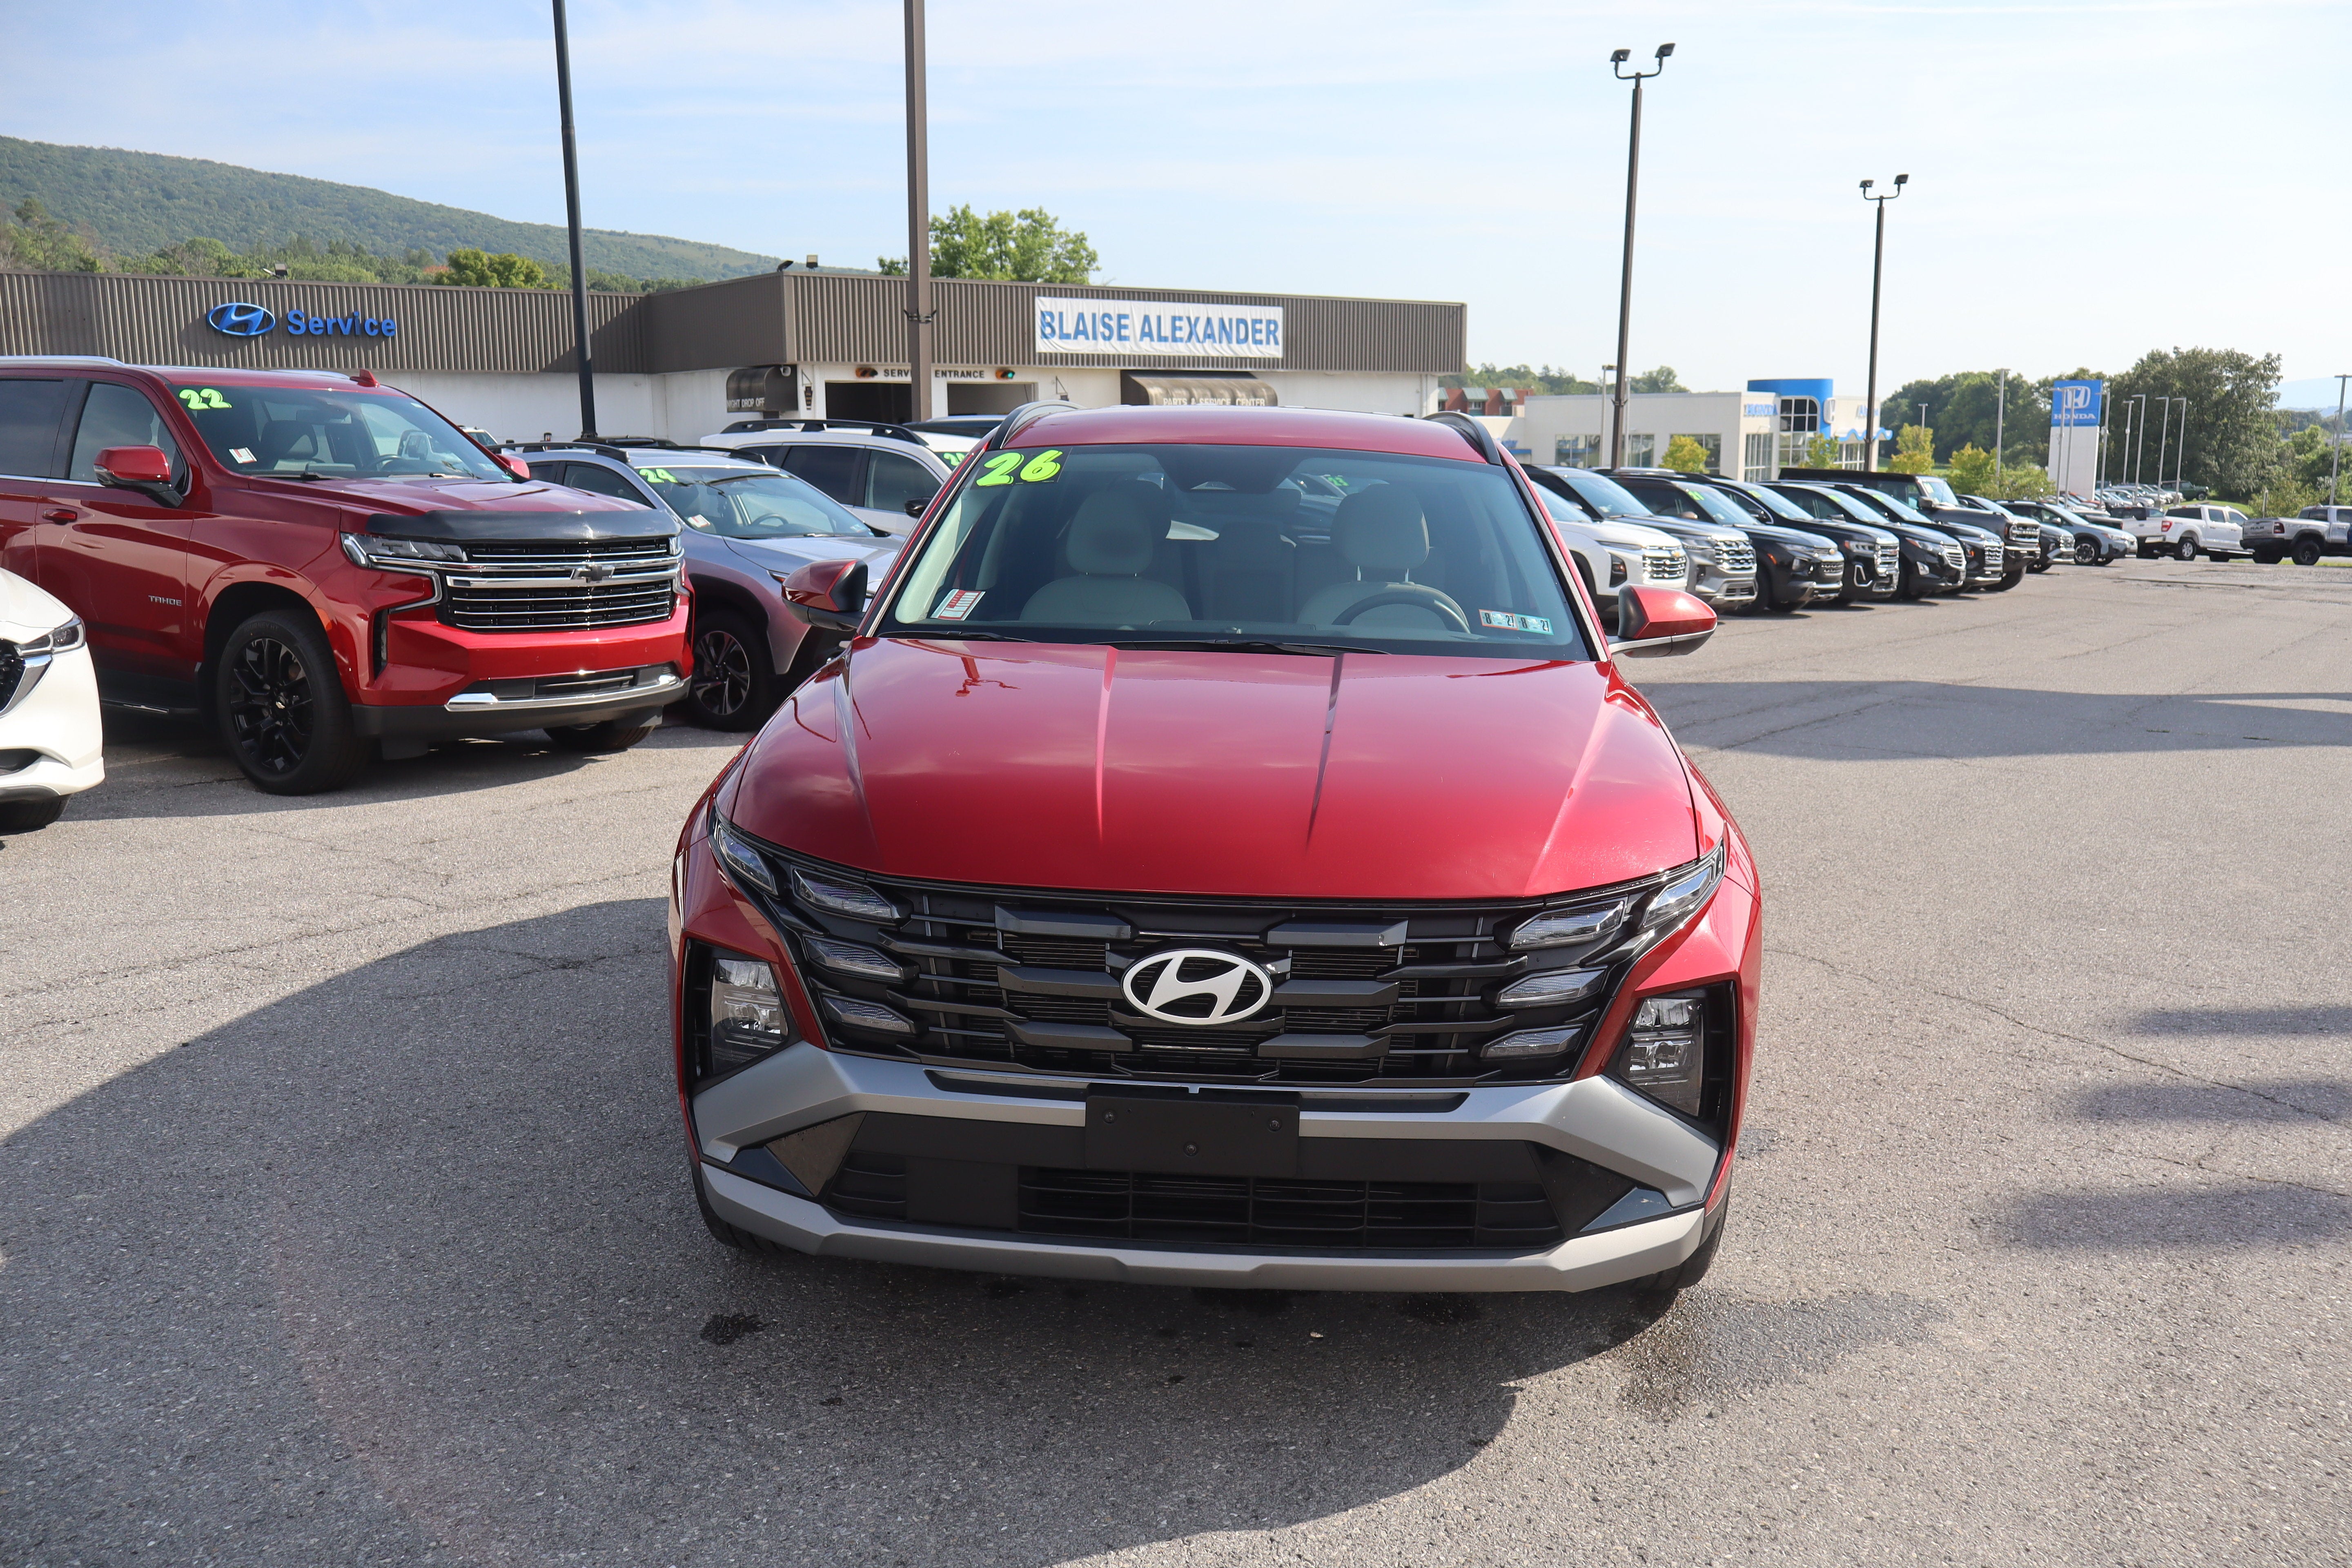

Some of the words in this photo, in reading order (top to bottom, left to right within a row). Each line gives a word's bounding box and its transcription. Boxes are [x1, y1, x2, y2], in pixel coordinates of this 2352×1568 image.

[287, 309, 396, 336] Service
[1041, 310, 1130, 341] BLAISE
[1139, 314, 1280, 346] ALEXANDER
[884, 369, 913, 377] SERV
[935, 370, 984, 378] ENTRANCE
[179, 388, 232, 410] 22
[727, 399, 740, 408] NIGHT
[742, 398, 754, 408] DROP
[755, 397, 765, 407] OFF
[1746, 403, 1778, 415] HONDA
[639, 468, 678, 483] 24
[976, 450, 1063, 487] 26
[148, 595, 182, 606] TAHOE
[1484, 612, 1492, 624] 8
[1506, 615, 1514, 628] 27
[1520, 617, 1528, 629] 8
[1541, 620, 1549, 632] 27
